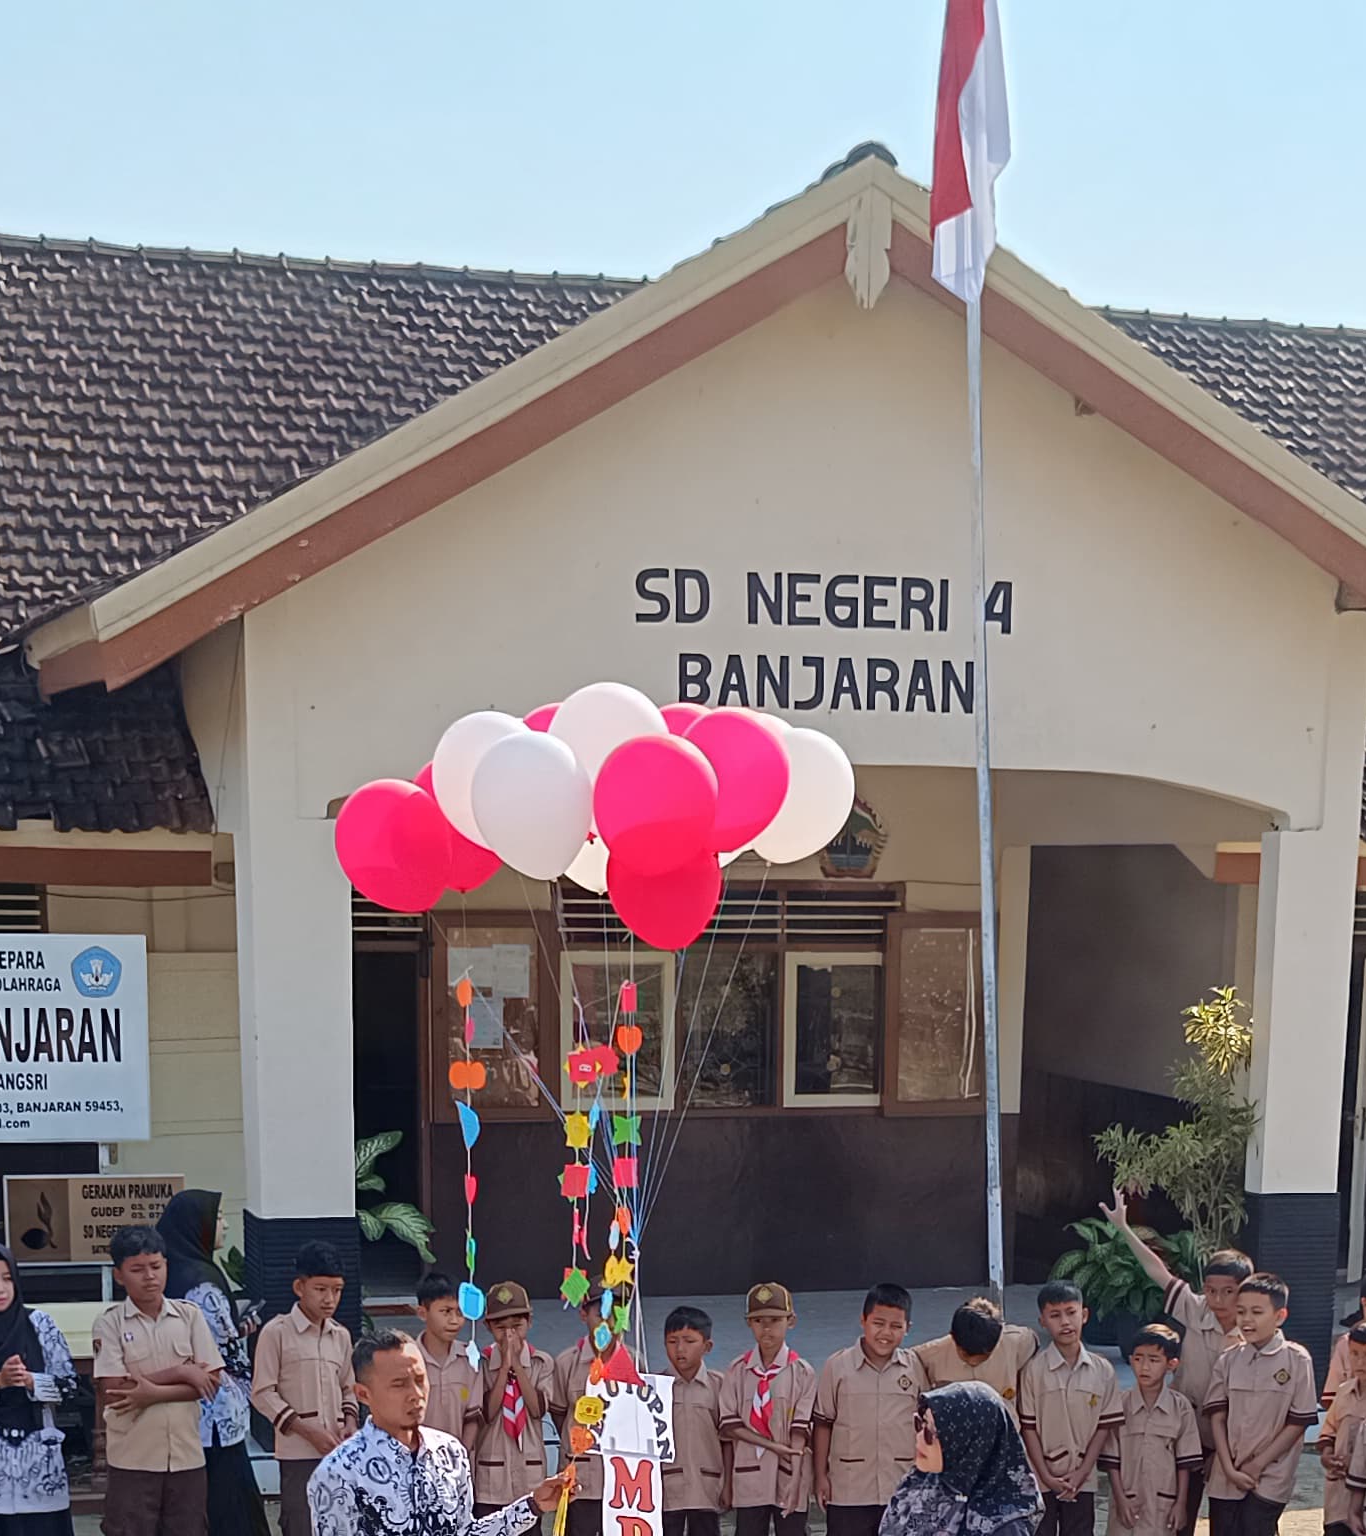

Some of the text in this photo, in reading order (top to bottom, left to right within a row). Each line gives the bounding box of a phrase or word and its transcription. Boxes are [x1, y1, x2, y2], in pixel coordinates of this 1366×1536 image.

[635, 567, 1013, 635] SD NEGERI 4
[678, 652, 975, 714] BANJARAN
[16, 1101, 82, 1114] BANJARAN
[85, 1100, 124, 1113] 59453,
[82, 1184, 173, 1199] GERAKAN PRAMUKA
[91, 1206, 125, 1217] GUDEP
[83, 1224, 94, 1239] SD
